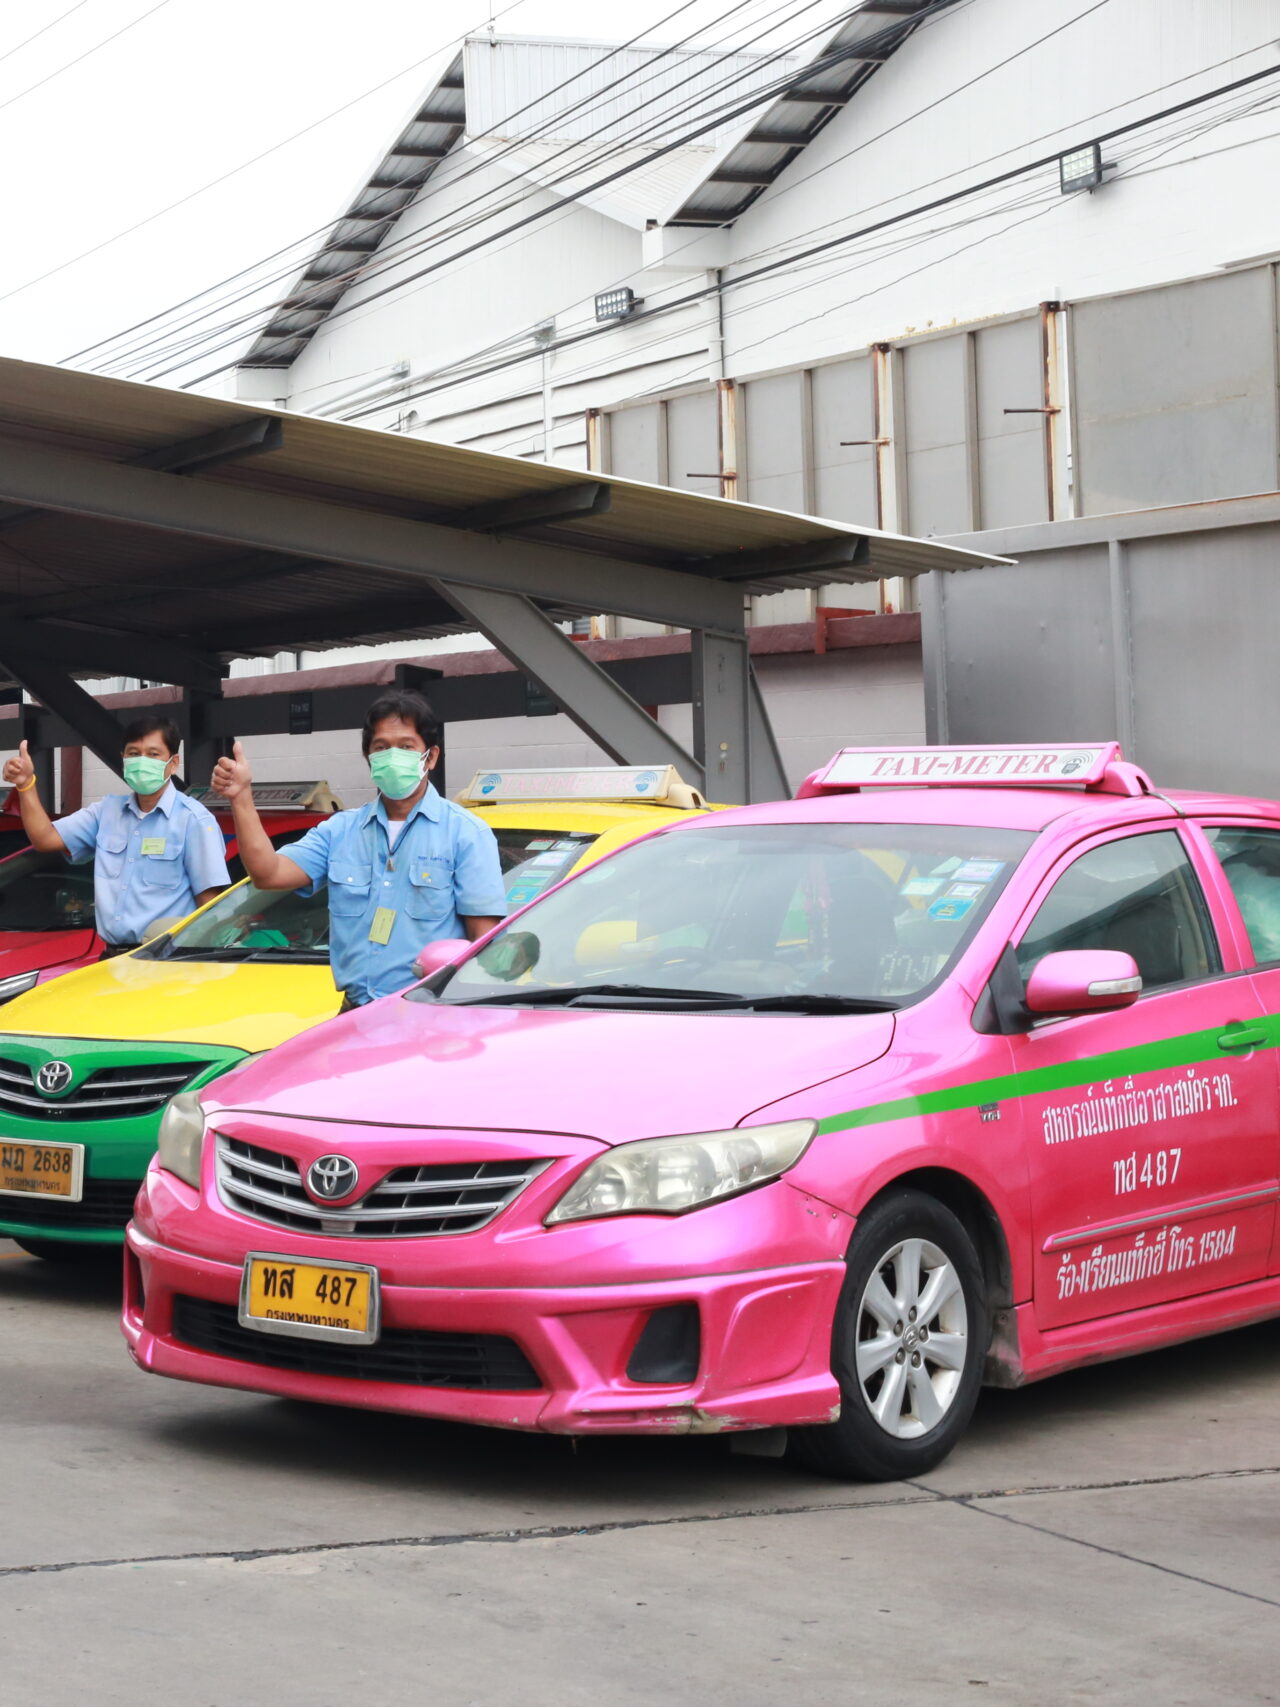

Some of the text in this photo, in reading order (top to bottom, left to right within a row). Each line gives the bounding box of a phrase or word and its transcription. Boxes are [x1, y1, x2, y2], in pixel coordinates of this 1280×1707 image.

[870, 754, 1059, 777] TAXI-METER
[33, 1149, 72, 1174] 2638
[1113, 1148, 1182, 1196] ทส 487
[1198, 1225, 1237, 1264] 1584
[263, 1266, 358, 1307] ทส 487
